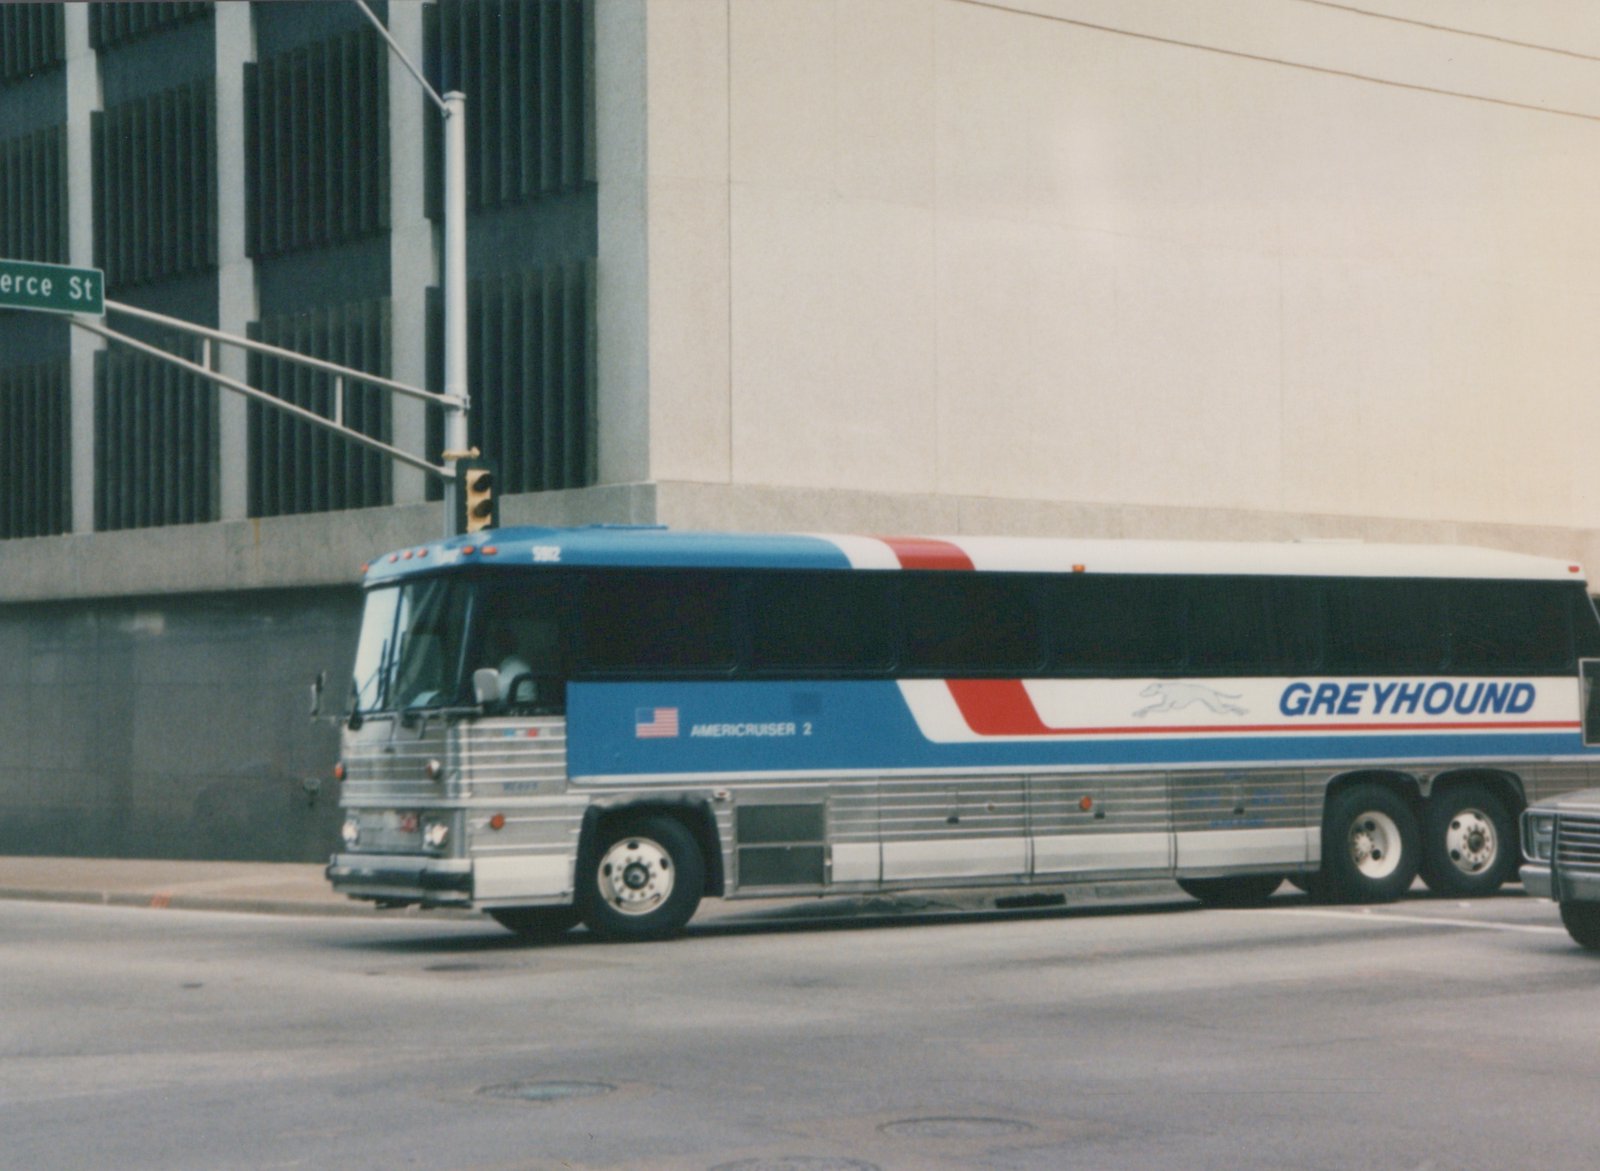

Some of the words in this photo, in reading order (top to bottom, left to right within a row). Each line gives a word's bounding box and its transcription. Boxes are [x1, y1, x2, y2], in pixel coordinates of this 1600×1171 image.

[0, 274, 52, 296] erce
[69, 275, 93, 301] St
[1279, 681, 1536, 717] GREYHOUND
[690, 722, 796, 737] AMERICRUISER
[802, 722, 813, 736] 2
